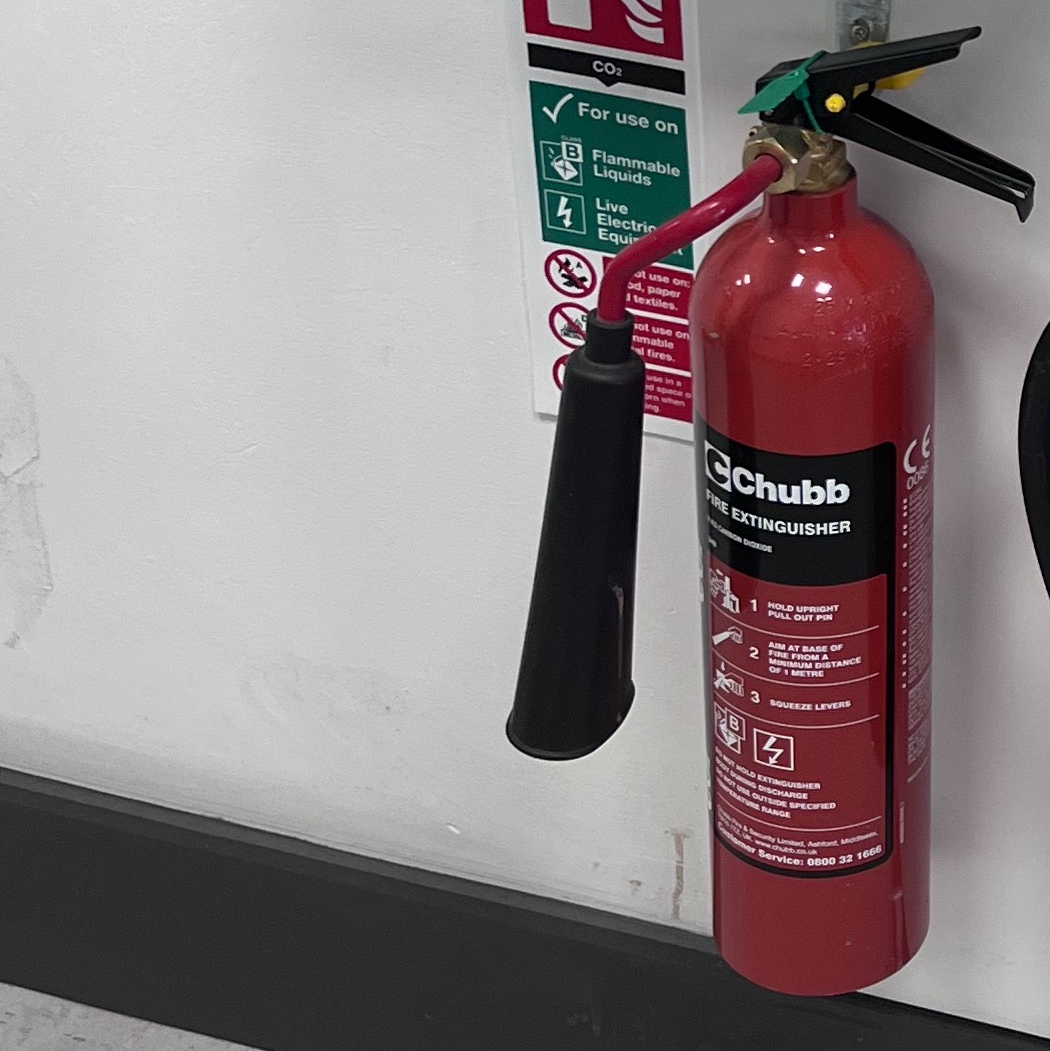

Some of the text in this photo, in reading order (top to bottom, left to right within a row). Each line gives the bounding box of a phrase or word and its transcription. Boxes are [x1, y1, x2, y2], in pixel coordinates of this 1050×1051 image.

[578, 102, 679, 135] For use on
[566, 144, 580, 159] B
[592, 149, 681, 177] Flammable
[593, 164, 652, 186] Liquids
[595, 198, 629, 214] Live
[649, 273, 691, 288] use on:
[648, 285, 681, 299] paper
[634, 294, 678, 311] textiles.
[652, 325, 672, 337] use
[647, 347, 675, 362] fires.
[732, 466, 850, 506] Chubb
[706, 488, 730, 516] FIRE
[731, 506, 851, 536] EXTINGUISHER
[750, 599, 757, 612] 1
[768, 601, 840, 613] HOLD UPRIGHT
[768, 610, 833, 621] PULL OUT PIN
[749, 647, 760, 660] 2
[768, 641, 786, 651] AIM
[802, 645, 828, 653] BASE
[830, 643, 844, 652] OF
[768, 649, 789, 660] FIRE
[791, 652, 820, 661] FROM
[768, 656, 862, 669] MINIMUM DISTANCE
[768, 666, 781, 674] OF
[791, 669, 824, 678] METRE
[750, 691, 760, 704] 3
[769, 699, 851, 711] SQUEEZE LEVERS
[729, 716, 739, 731] B
[757, 773, 821, 790] EXTINGUISHER
[758, 784, 808, 800] DISCHARGE
[752, 793, 836, 810] OUTSIDE SPECIFIED
[761, 805, 791, 819] RANGE
[758, 849, 804, 866] Service:
[807, 857, 836, 866] 0800
[839, 854, 853, 864] 32
